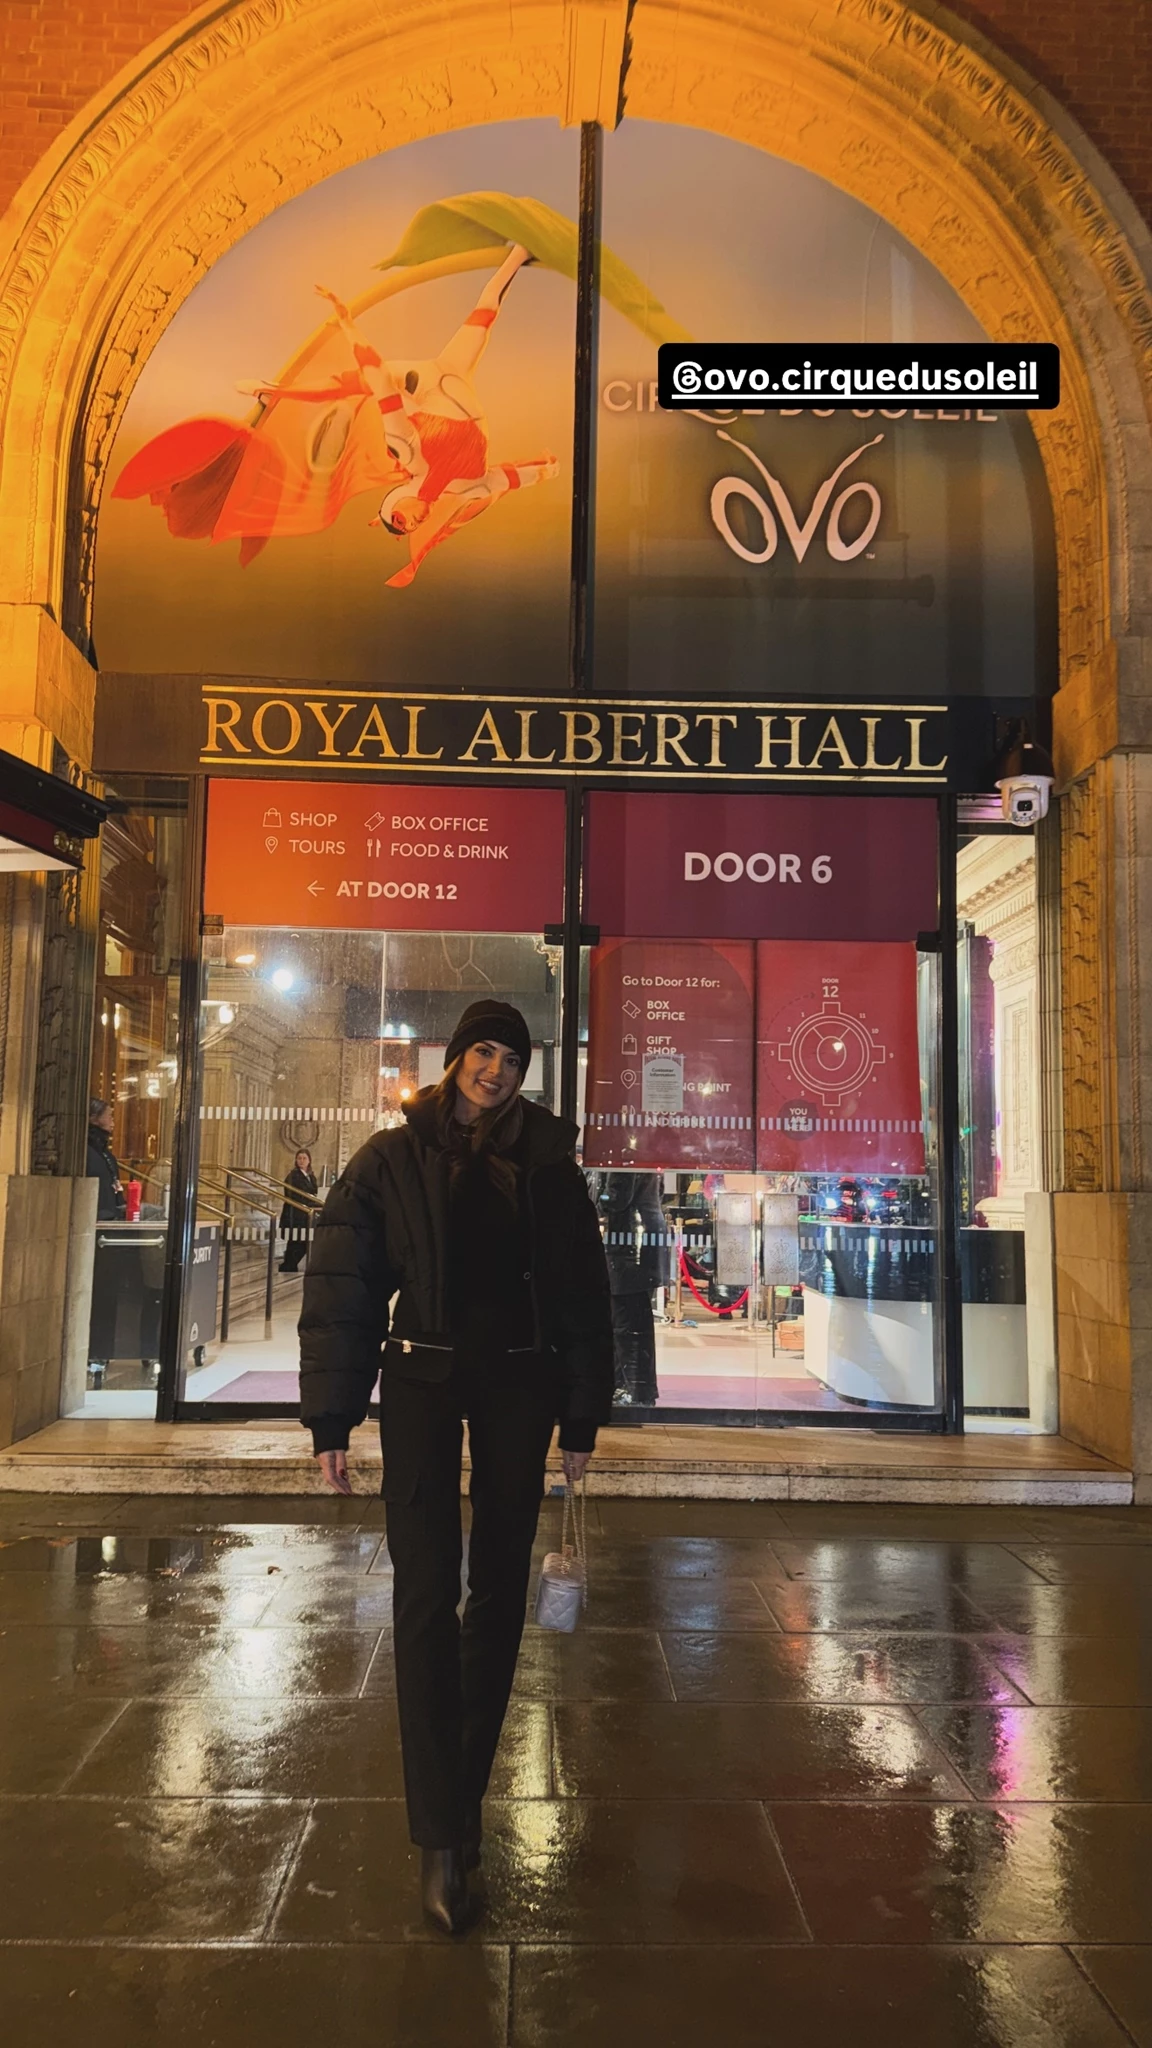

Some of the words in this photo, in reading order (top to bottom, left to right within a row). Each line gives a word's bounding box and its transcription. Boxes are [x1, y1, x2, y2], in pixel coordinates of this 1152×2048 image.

[711, 429, 884, 563] OVO
[200, 698, 444, 759] ROYAL
[457, 707, 737, 767] ALBERT
[754, 716, 948, 771] HALL
[289, 812, 338, 828] SHOP
[391, 816, 426, 830] BOX
[430, 817, 489, 832] OFFICE
[289, 839, 346, 855] TOURS
[391, 843, 440, 858] FOOD
[442, 844, 455, 859] &
[458, 844, 509, 860] DRINK
[684, 851, 802, 884] DOOR
[811, 855, 833, 884] 6
[336, 880, 364, 897] AT
[367, 881, 430, 899] DOOR
[435, 884, 458, 900] 12
[622, 975, 638, 986] Go
[641, 977, 653, 986] to
[655, 976, 683, 987] Door
[686, 978, 698, 987] 12
[700, 978, 720, 988] for:
[823, 986, 839, 998] 12
[647, 1001, 670, 1010] BOX
[646, 1011, 685, 1021] OFFICE
[646, 1035, 672, 1045] GIFT
[646, 1046, 677, 1055] SHOP
[645, 1117, 670, 1127] AND
[790, 1116, 807, 1124] ARE
